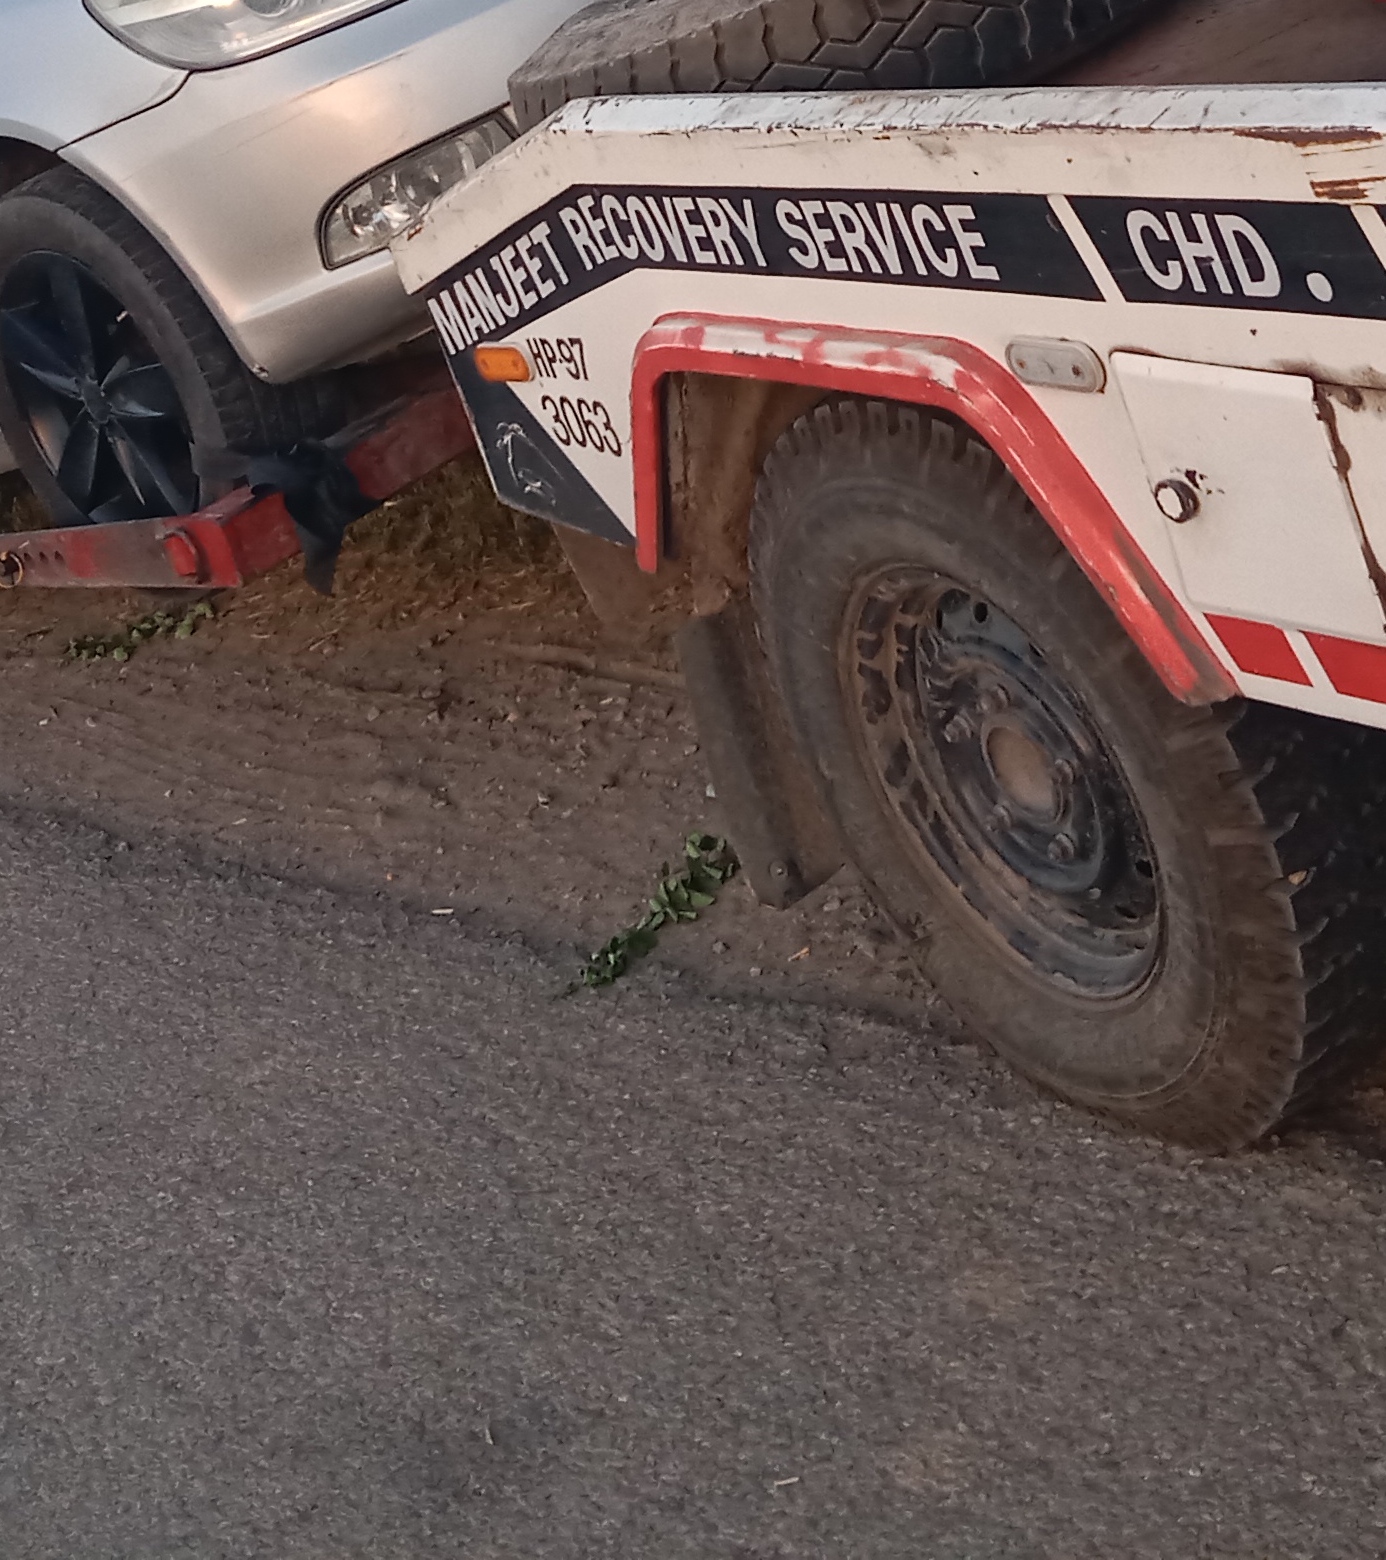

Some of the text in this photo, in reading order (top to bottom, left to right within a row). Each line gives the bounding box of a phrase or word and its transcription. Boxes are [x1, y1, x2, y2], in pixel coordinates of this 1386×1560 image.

[427, 194, 1001, 355] MANJEET RECOVERY SERVICE
[541, 395, 622, 457] 3063
